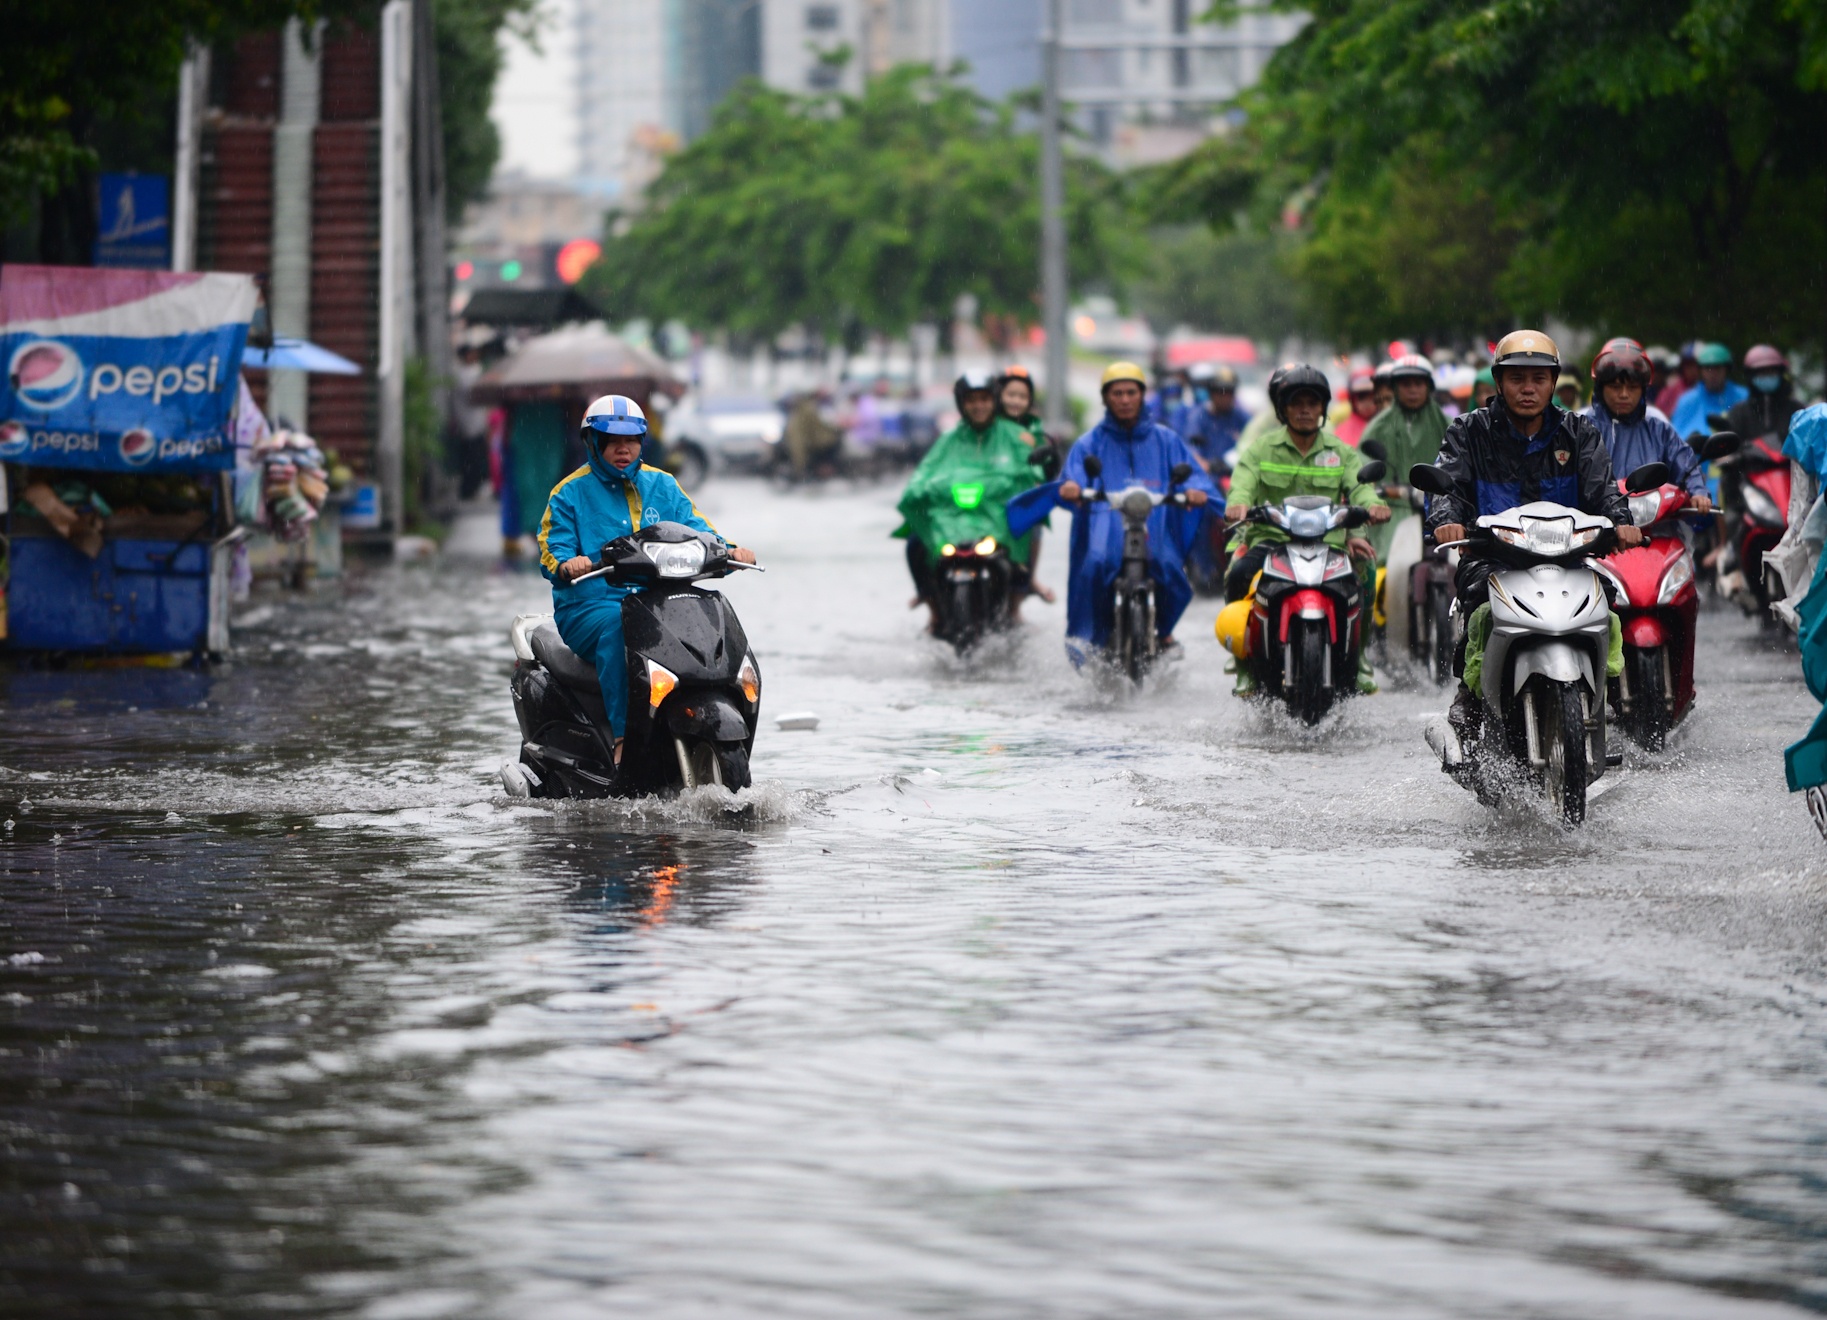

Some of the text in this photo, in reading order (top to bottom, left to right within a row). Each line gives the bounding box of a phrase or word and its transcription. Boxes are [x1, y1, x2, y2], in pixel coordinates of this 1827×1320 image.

[90, 356, 219, 404] pepsi
[32, 430, 99, 453] pepsi
[158, 435, 222, 459] pepsi
